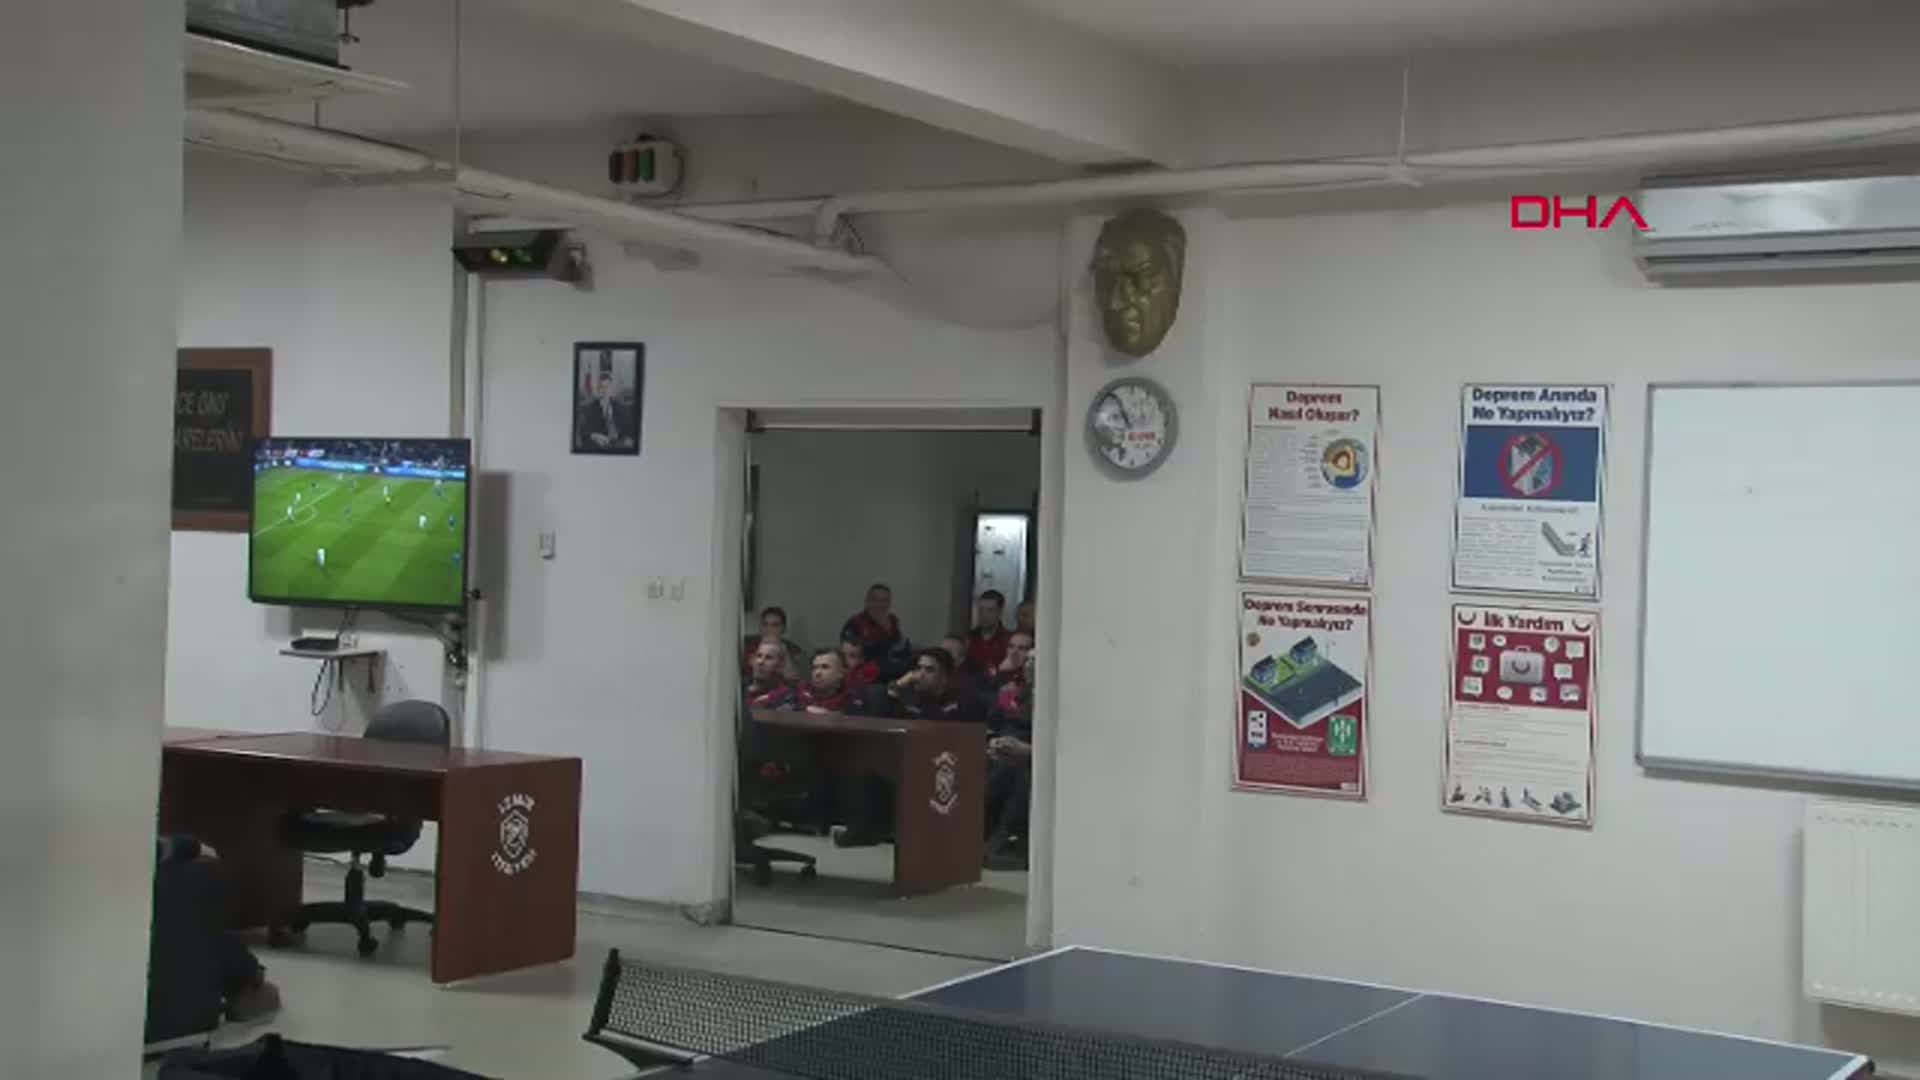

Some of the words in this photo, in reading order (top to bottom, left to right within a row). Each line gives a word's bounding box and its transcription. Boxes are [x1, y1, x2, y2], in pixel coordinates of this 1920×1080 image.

[1473, 388, 1536, 403] Deprem
[1472, 406, 1495, 419] Ne
[1244, 599, 1294, 612] Deprem
